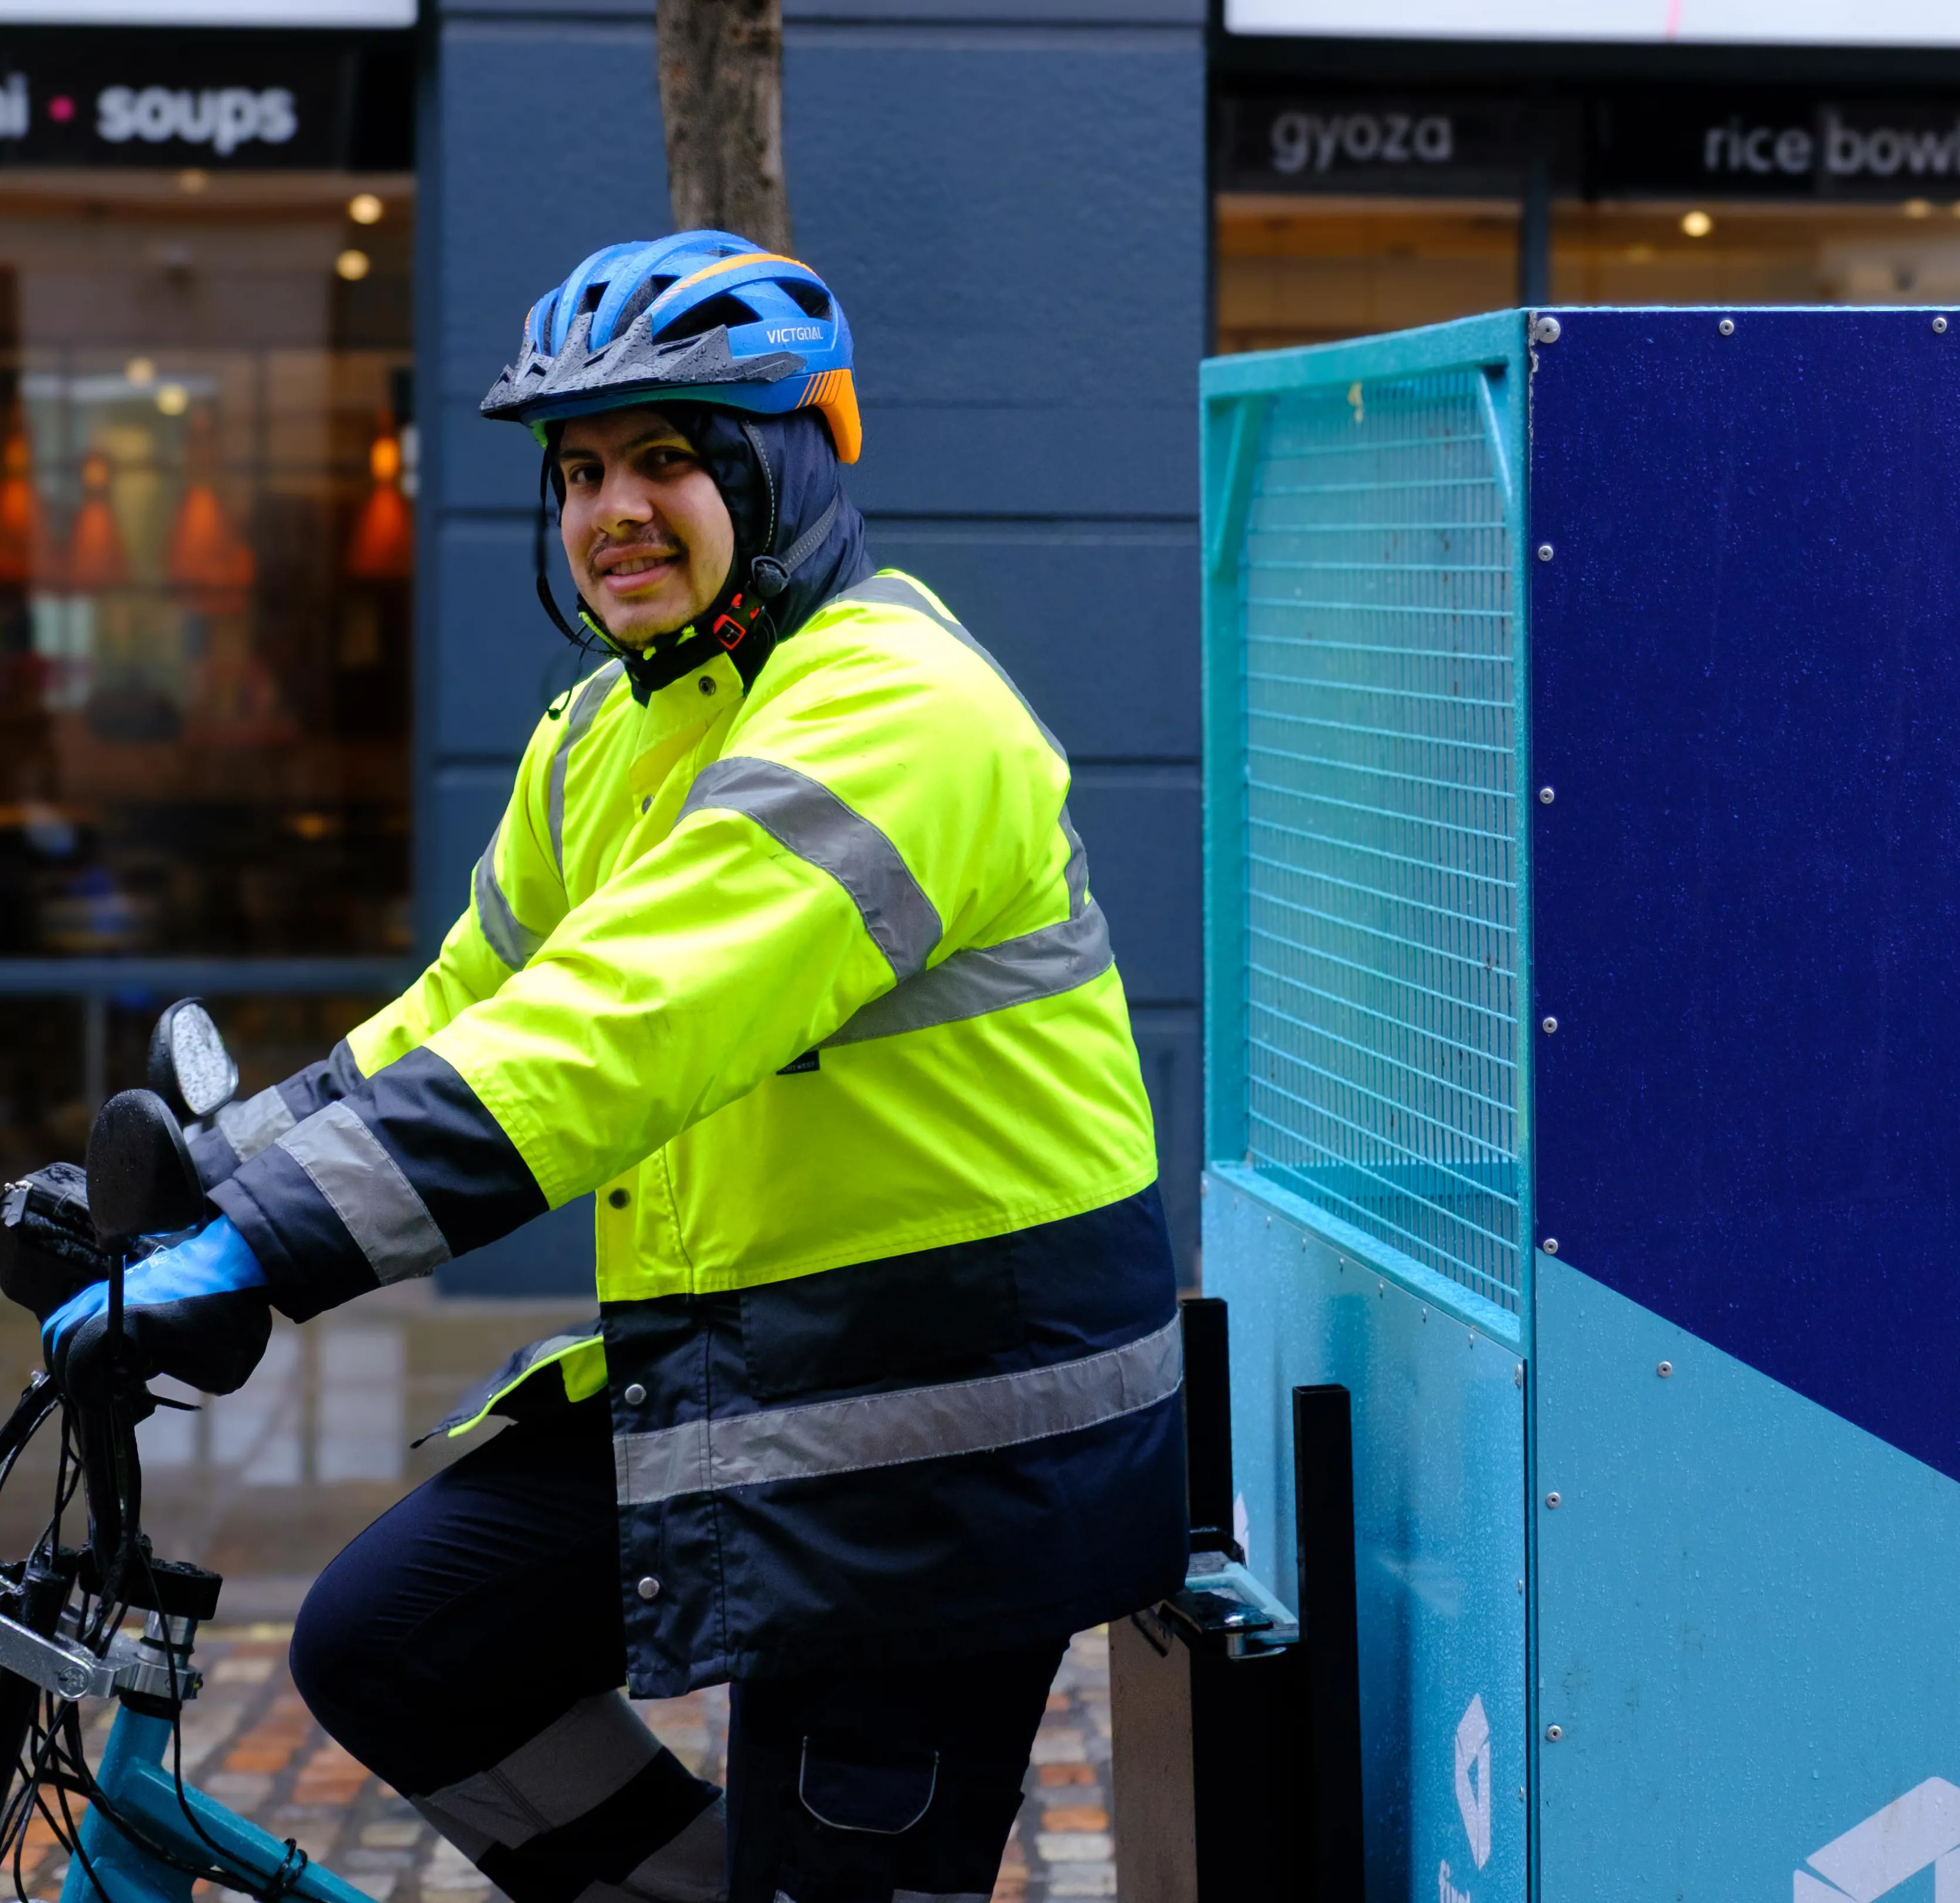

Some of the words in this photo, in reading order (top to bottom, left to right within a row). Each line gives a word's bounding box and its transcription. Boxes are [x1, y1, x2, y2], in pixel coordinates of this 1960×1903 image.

[0, 73, 28, 138] i
[97, 86, 297, 154] soups
[1271, 112, 1452, 173] gyoza
[1703, 117, 1813, 172] rice
[767, 327, 824, 344] VICTGOAL
